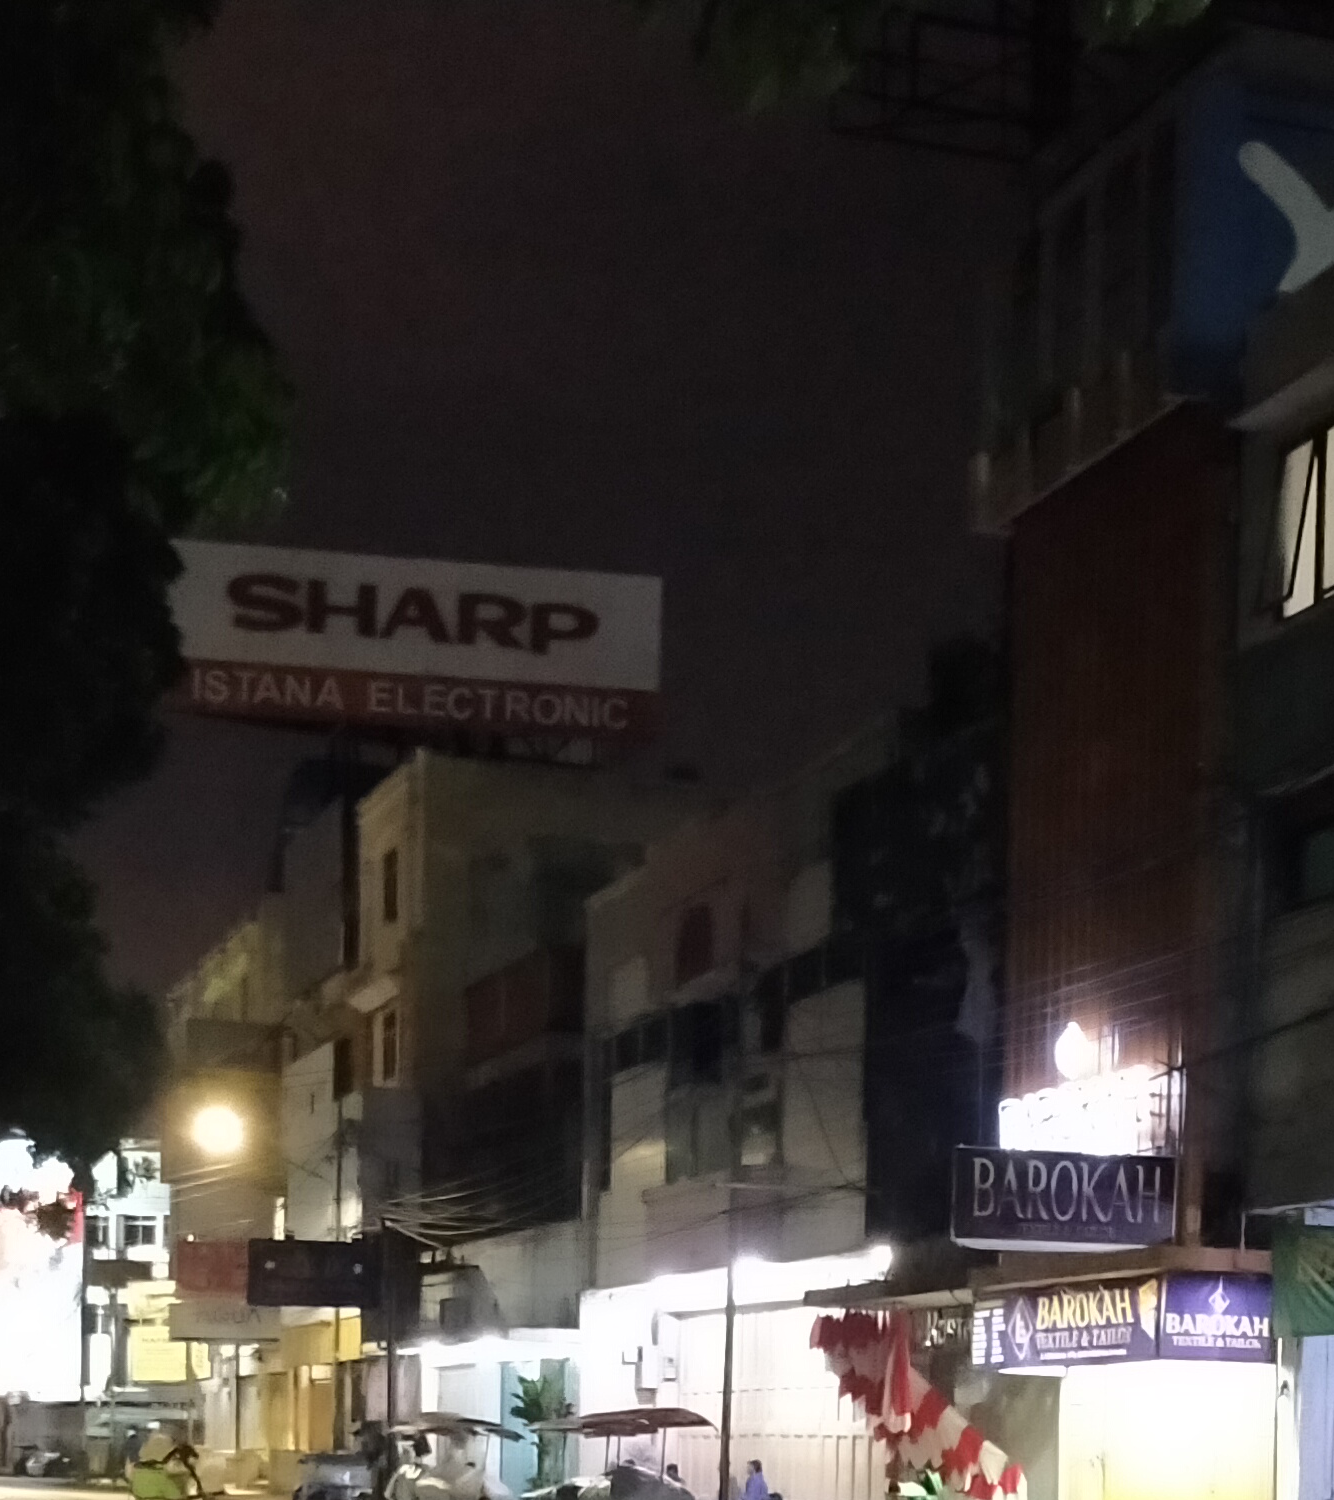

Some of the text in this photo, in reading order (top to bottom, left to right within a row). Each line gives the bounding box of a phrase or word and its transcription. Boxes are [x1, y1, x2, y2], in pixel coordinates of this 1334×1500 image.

[225, 572, 600, 657] SHARP
[191, 667, 629, 731] ISTANA ELECTRONIC
[972, 1156, 1164, 1224] BAROKAH
[1034, 1285, 1134, 1331] BAROKAH
[1165, 1311, 1270, 1338] BAROKAH
